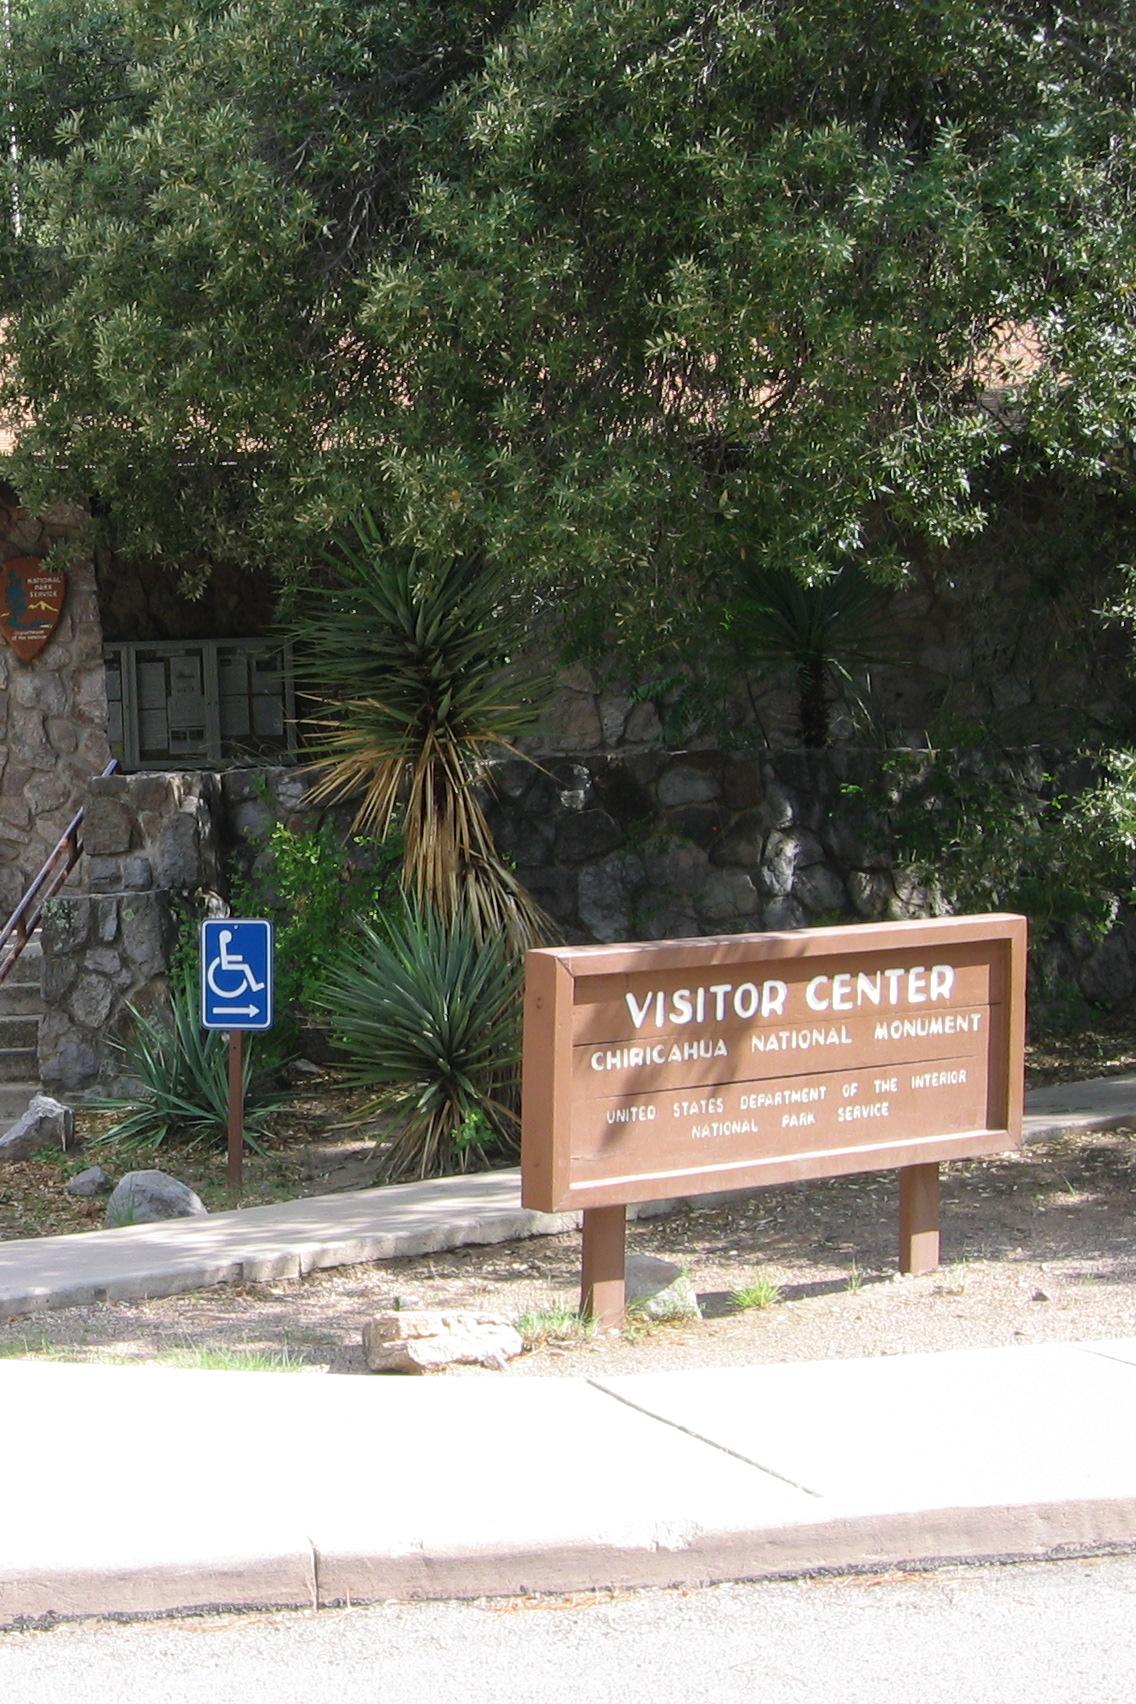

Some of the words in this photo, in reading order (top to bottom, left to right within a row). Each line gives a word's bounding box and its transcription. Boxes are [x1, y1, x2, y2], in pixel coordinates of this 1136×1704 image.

[626, 979, 788, 1030] VISITOR
[806, 963, 957, 1011] CENTER
[590, 1039, 728, 1072] CHIRICAHUA
[751, 1024, 853, 1053] NATIONAL
[874, 1012, 982, 1041] MONUMENT
[606, 1105, 656, 1126] UNITED
[673, 1097, 724, 1119] STATES
[740, 1085, 827, 1111] DEPARTMENT
[842, 1081, 858, 1098] OF
[873, 1077, 898, 1095] THE
[911, 1068, 968, 1090] INTERIOR
[691, 1119, 759, 1140] NATIONAL
[781, 1111, 817, 1130] PARK
[837, 1102, 890, 1124] SERVICE
